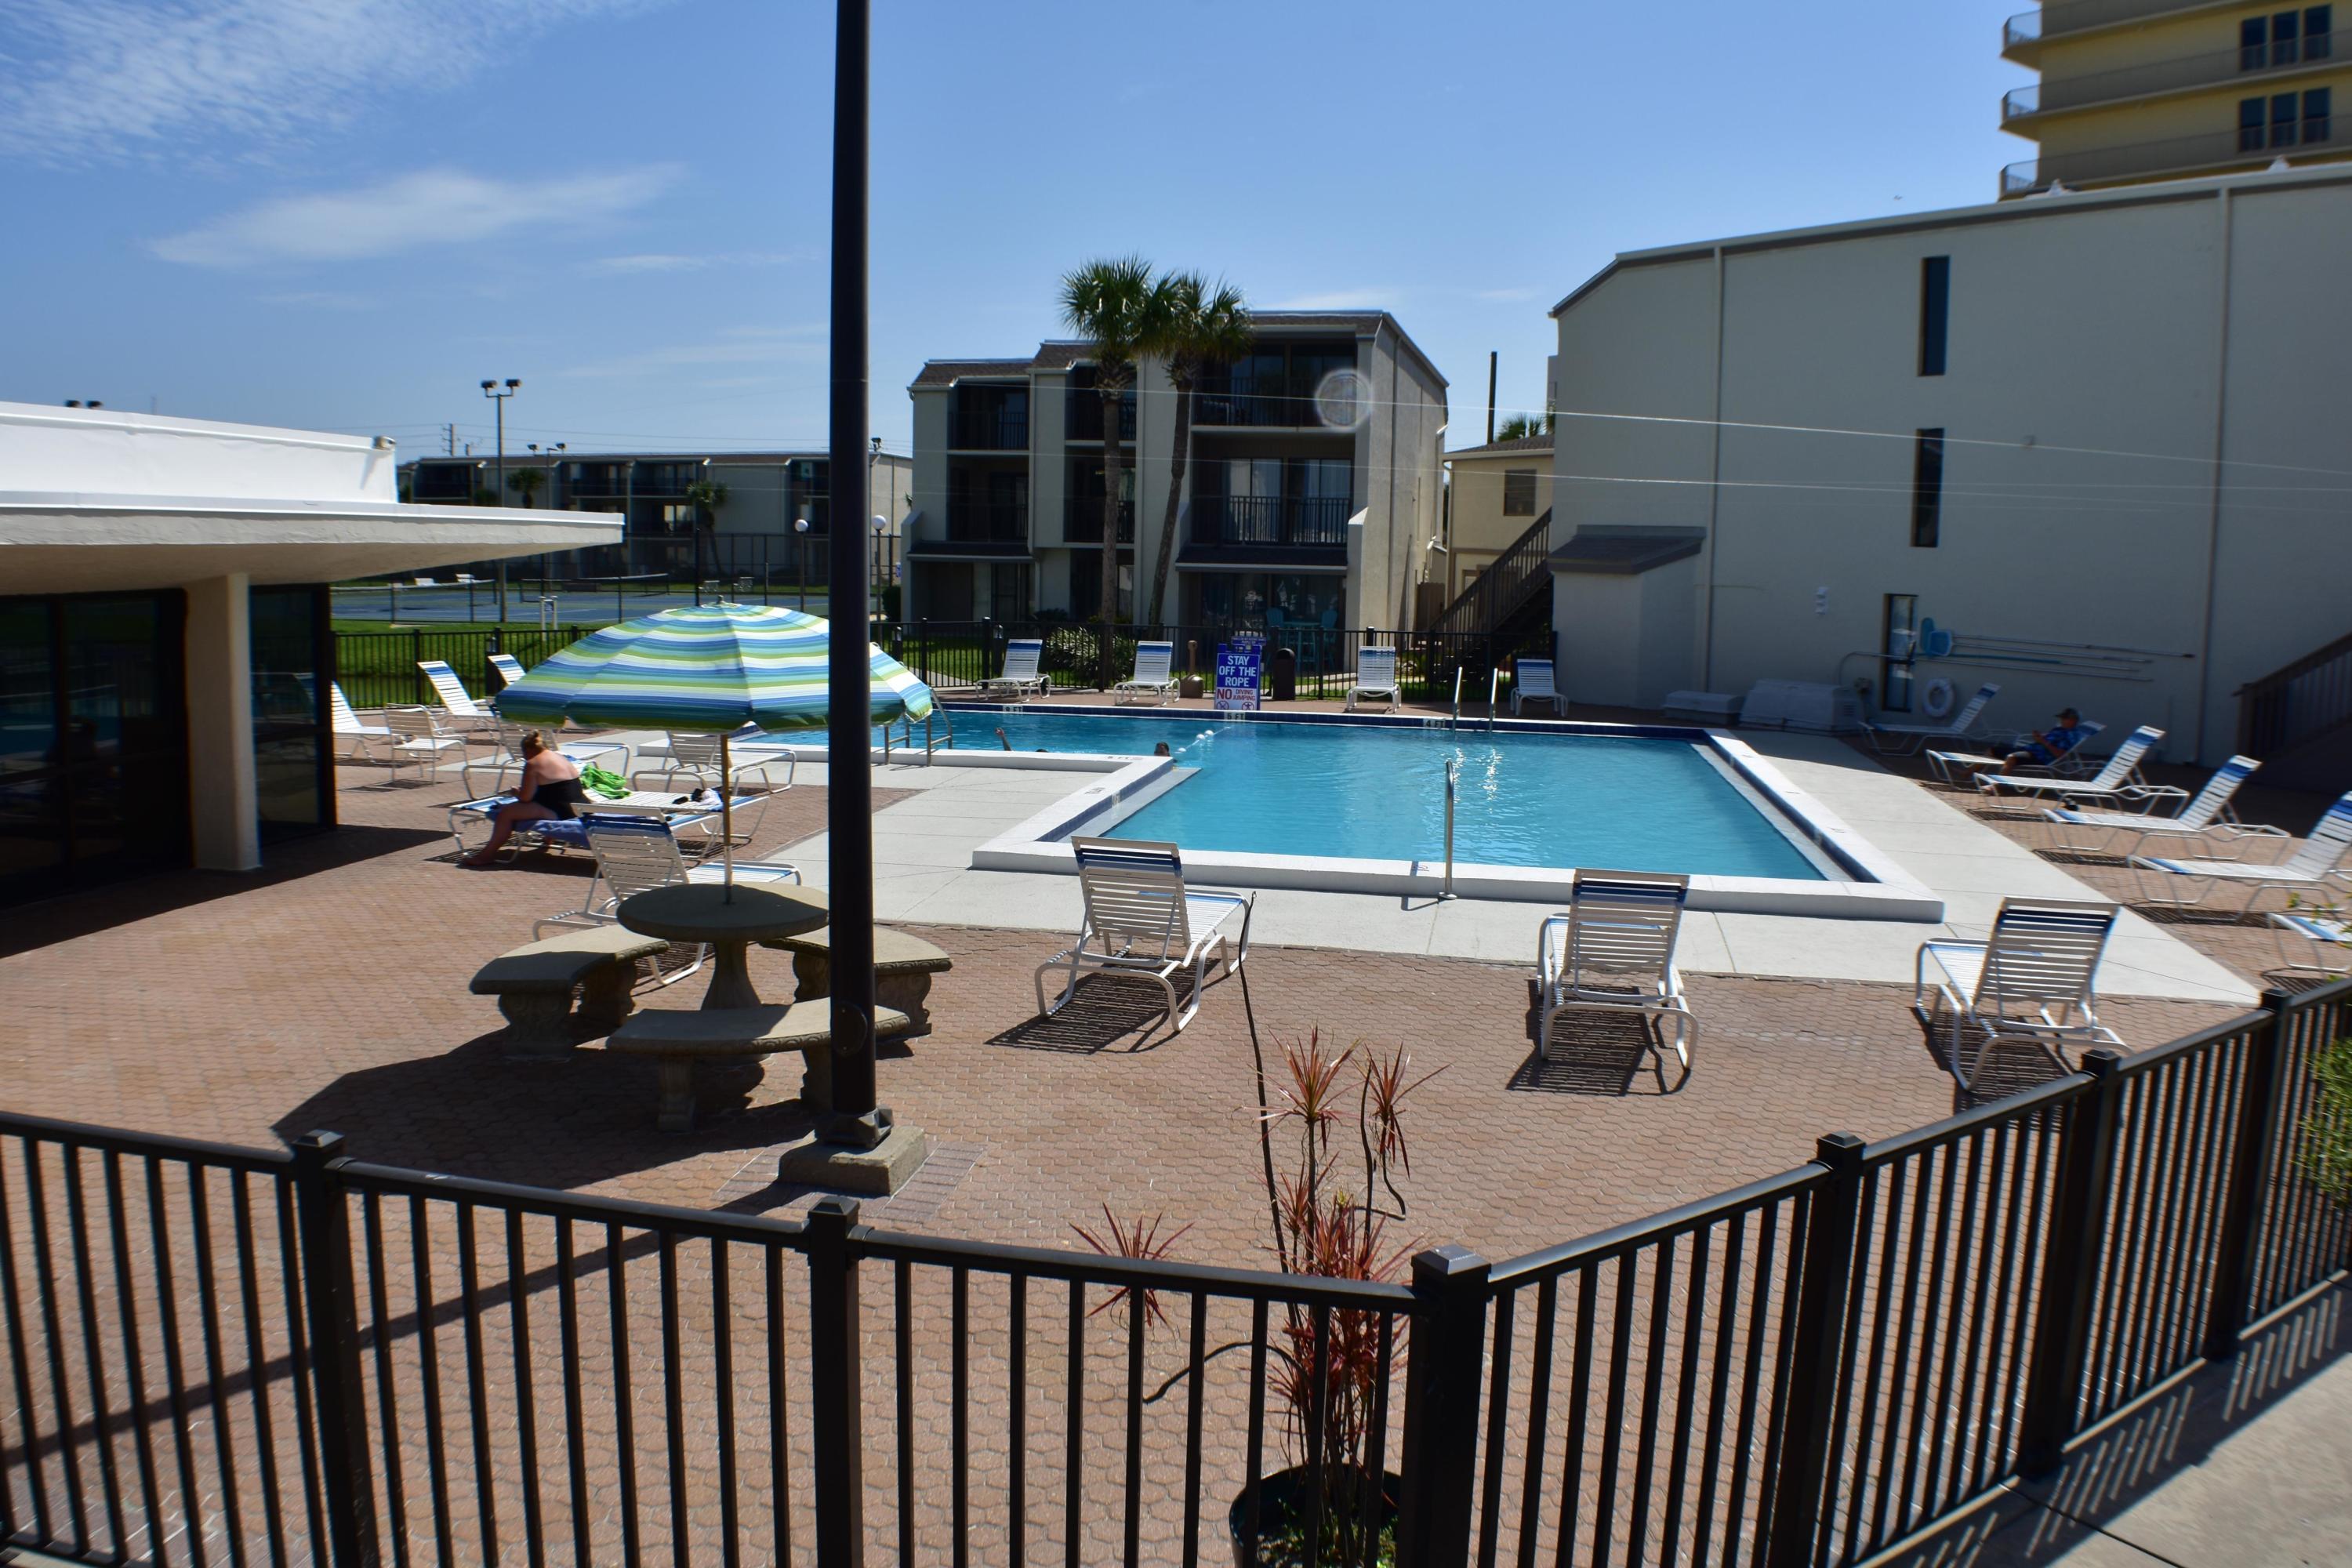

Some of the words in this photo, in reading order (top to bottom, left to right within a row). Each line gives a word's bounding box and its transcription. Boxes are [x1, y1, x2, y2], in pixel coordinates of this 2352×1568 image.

[1228, 655, 1250, 665] STAY
[1218, 666, 1236, 676] OFF
[1239, 667, 1256, 677] THE
[1225, 677, 1250, 687] ROPE
[1217, 688, 1232, 699] NO
